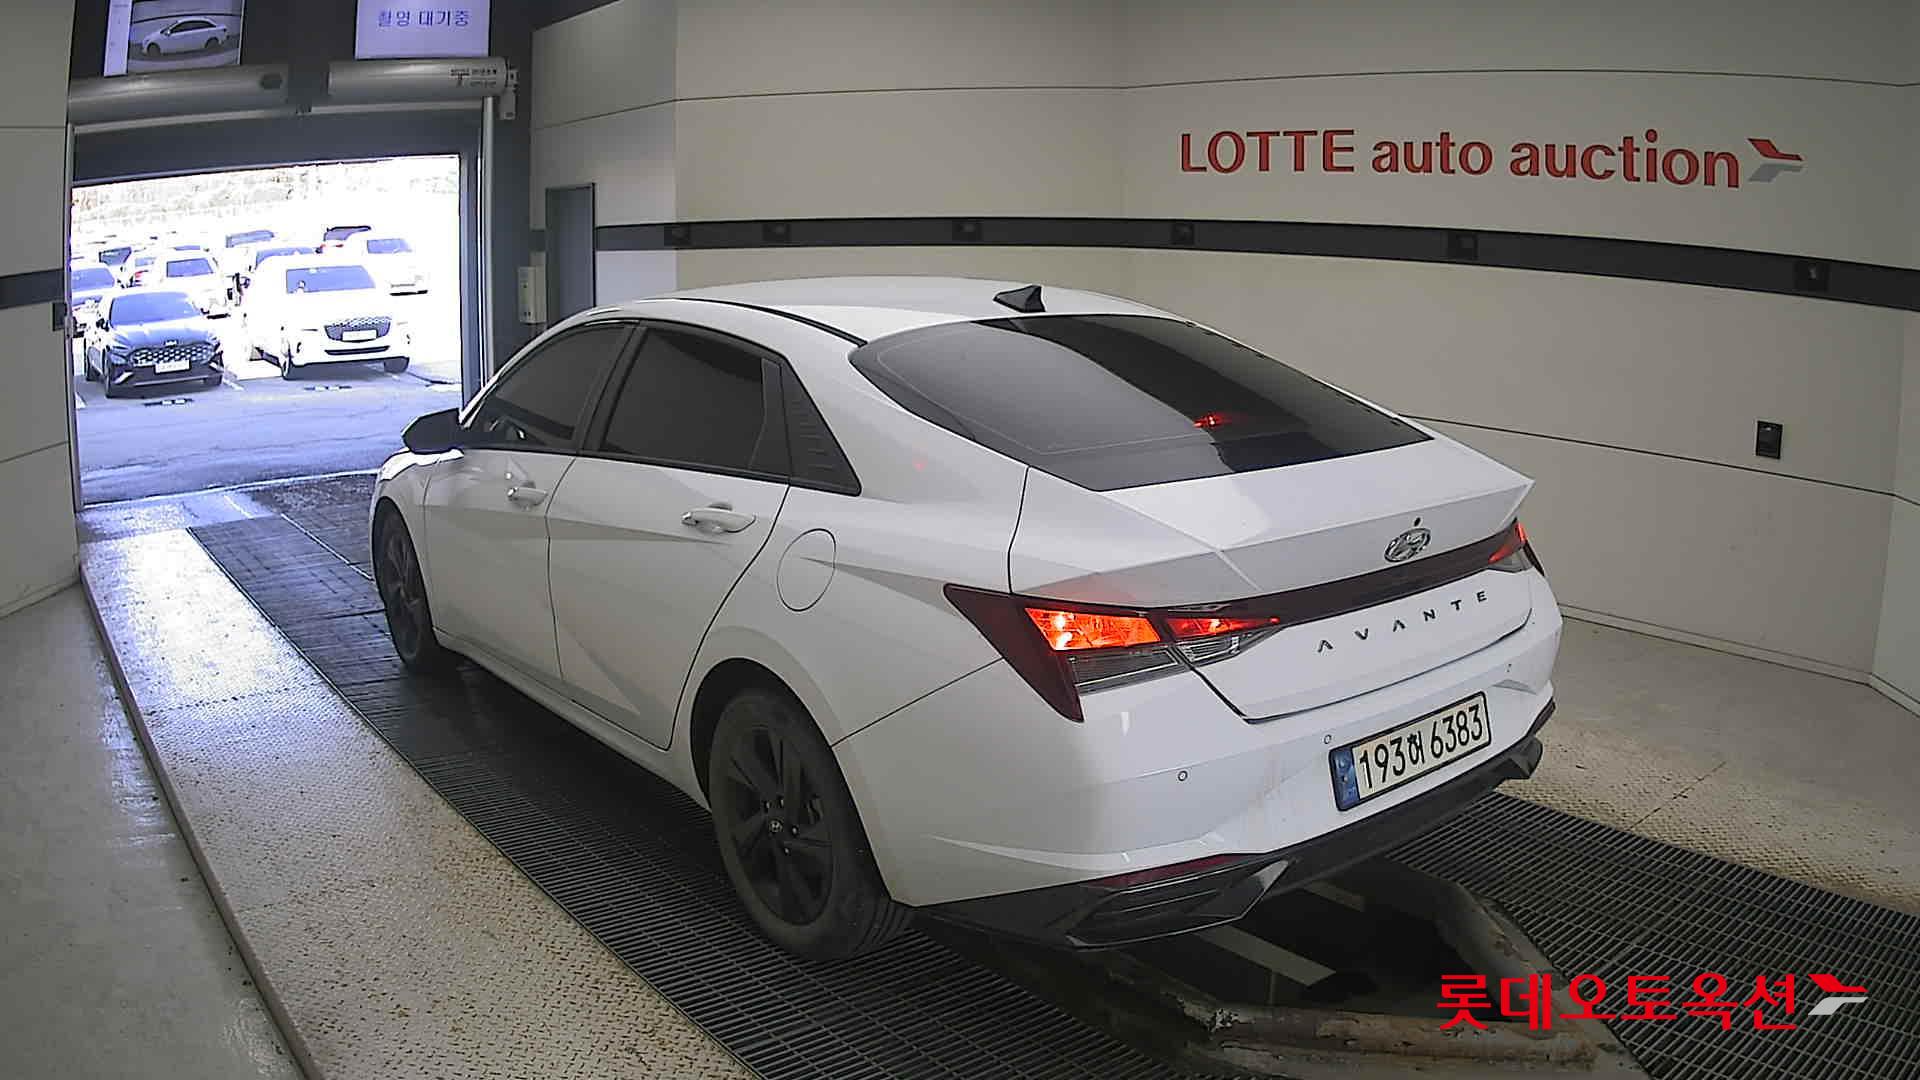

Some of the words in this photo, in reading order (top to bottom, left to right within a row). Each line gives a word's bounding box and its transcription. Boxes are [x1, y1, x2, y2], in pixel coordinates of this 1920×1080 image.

[418, 10, 468, 27] 대기중
[1181, 129, 1355, 174] LOTTE
[1371, 131, 1494, 175] auto
[1509, 130, 1740, 188] auction
[1317, 591, 1487, 653] AVANTE
[1430, 703, 1483, 758] 6383
